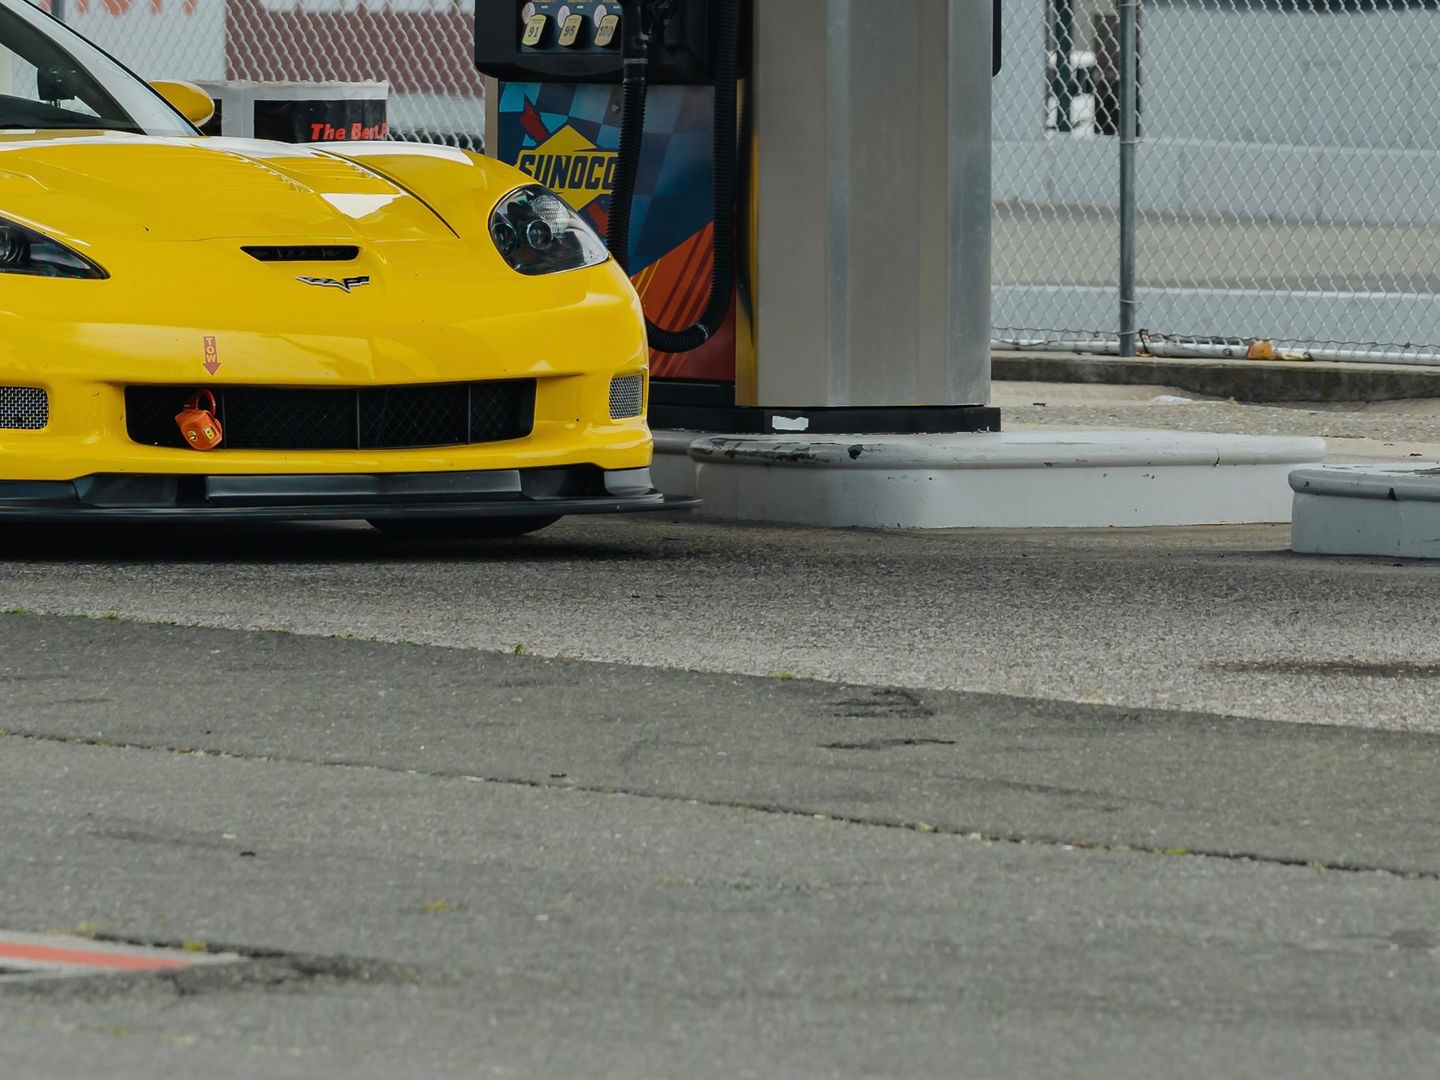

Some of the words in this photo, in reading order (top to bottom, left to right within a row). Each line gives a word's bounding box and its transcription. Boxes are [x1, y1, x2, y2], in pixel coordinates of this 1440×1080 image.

[528, 26, 539, 37] 91
[310, 122, 346, 141] The
[205, 337, 217, 363] TOW
